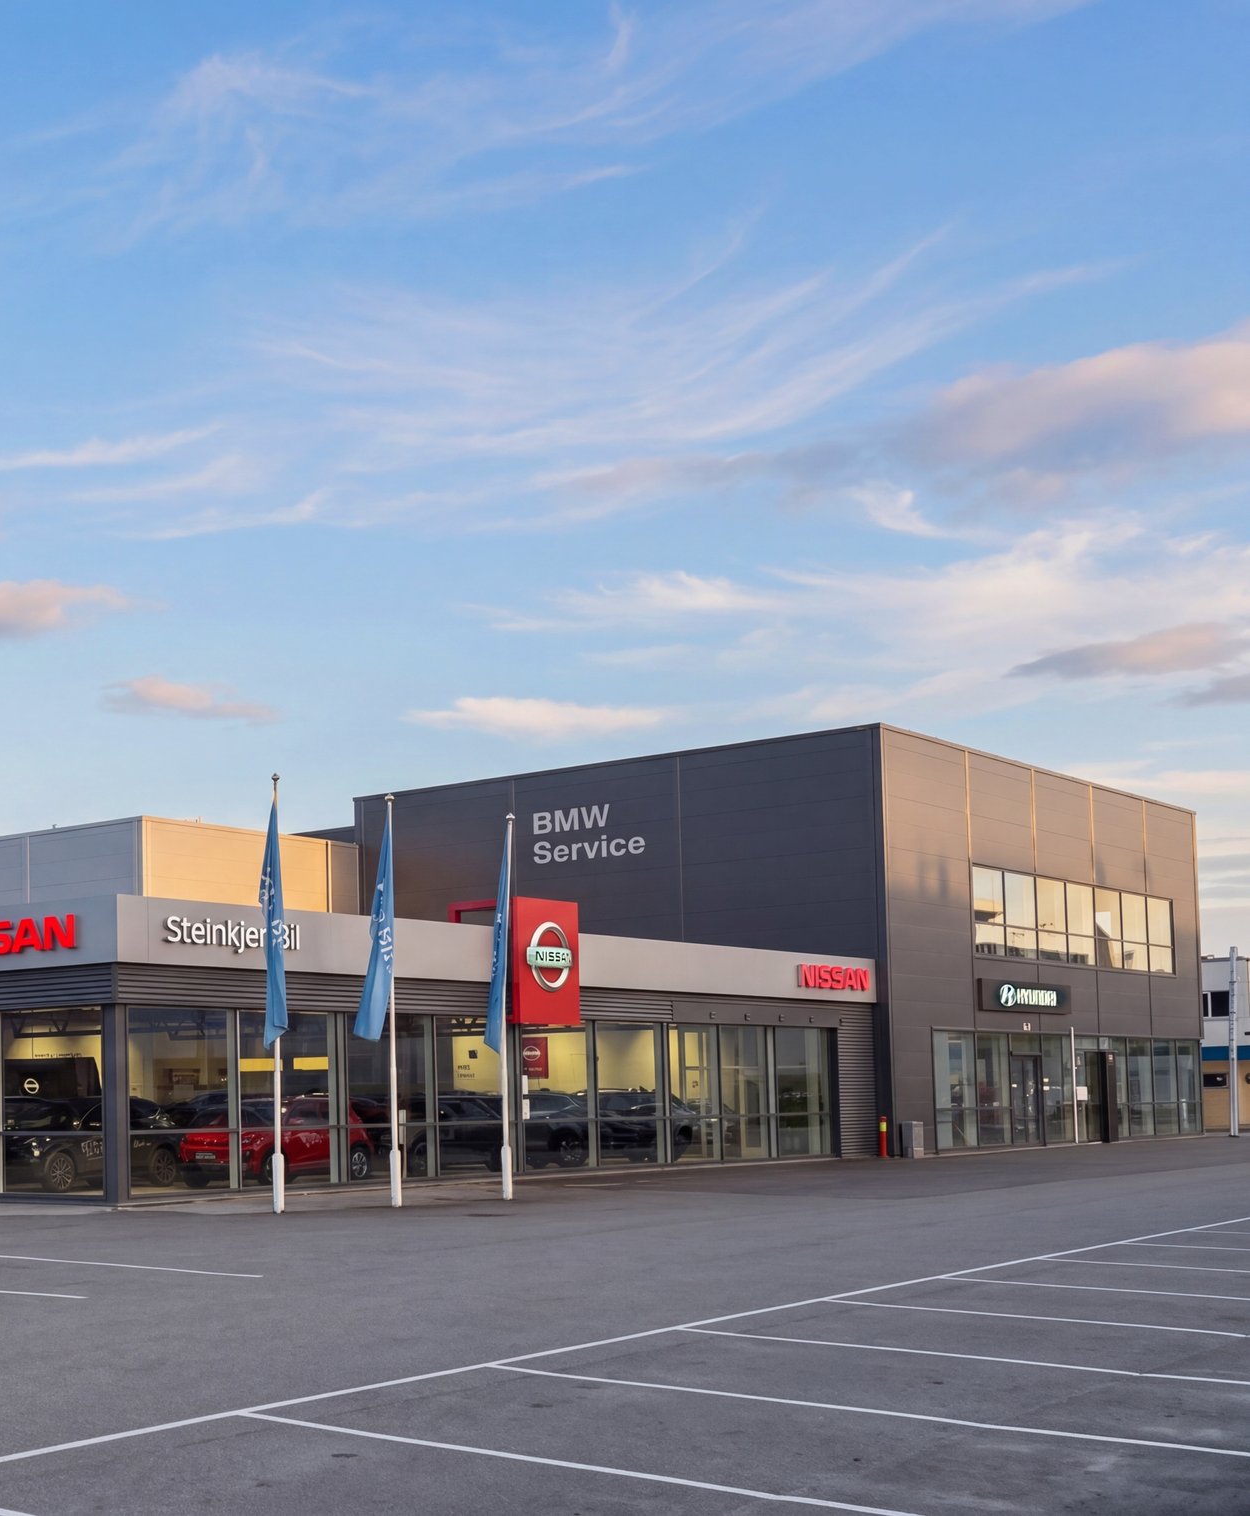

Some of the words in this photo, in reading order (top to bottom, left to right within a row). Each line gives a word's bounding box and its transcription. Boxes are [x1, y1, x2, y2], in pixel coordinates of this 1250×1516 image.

[532, 803, 610, 835] BMW
[533, 834, 646, 865] Service
[164, 915, 268, 954] Steinkjer
[798, 963, 870, 992] NISSAN
[1016, 988, 1057, 1007] HYUNDAI
